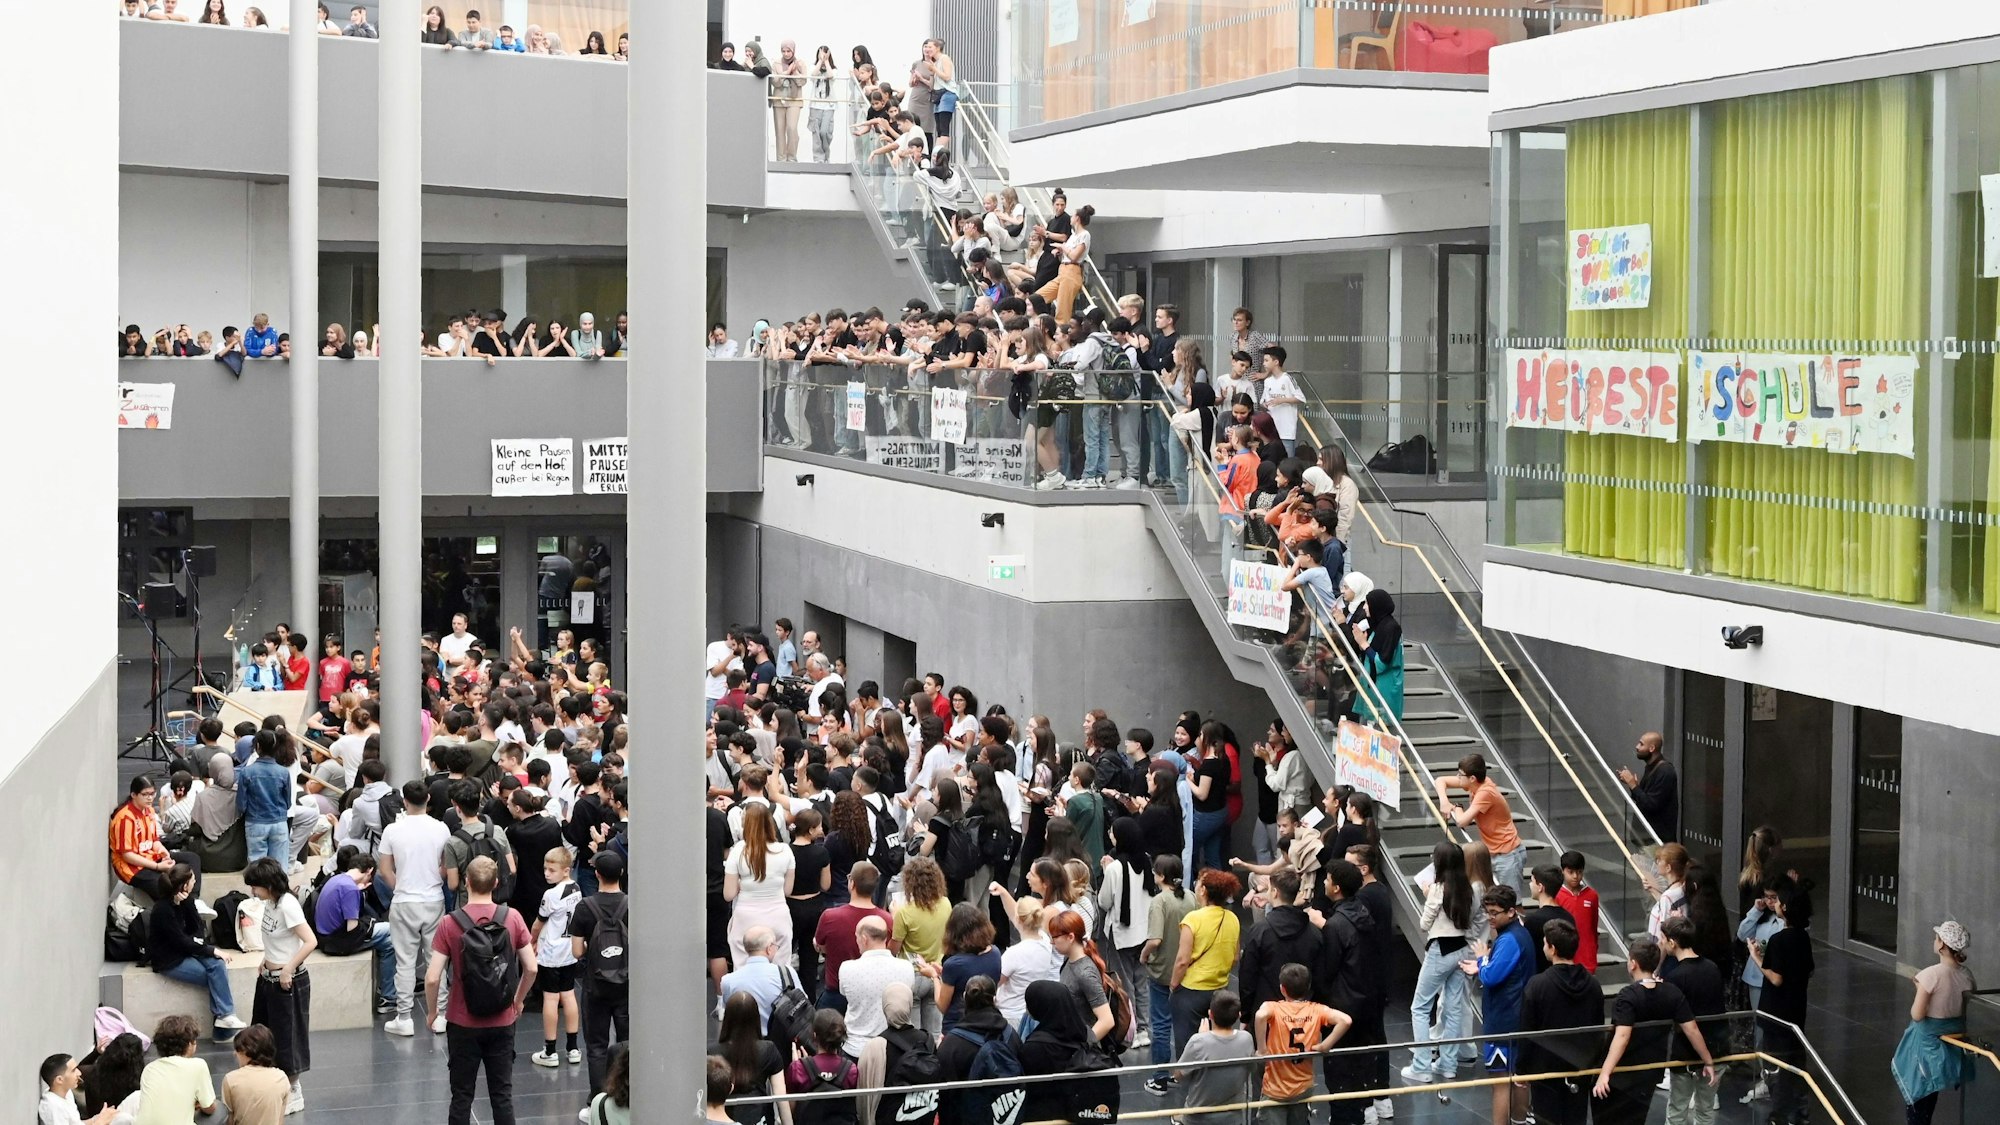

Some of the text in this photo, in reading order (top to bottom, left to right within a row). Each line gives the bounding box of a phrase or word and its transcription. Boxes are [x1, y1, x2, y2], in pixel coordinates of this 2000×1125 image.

[1712, 358, 1863, 424] SCHULE
[496, 443, 571, 459] Kleine Pausen
[497, 460, 516, 472] auf
[495, 472, 570, 486] außer bei Regen
[589, 472, 625, 483] ATRIUM
[1289, 1027, 1305, 1065] 5
[903, 1089, 940, 1111] NIKE
[1078, 1108, 1112, 1119] ellesse
